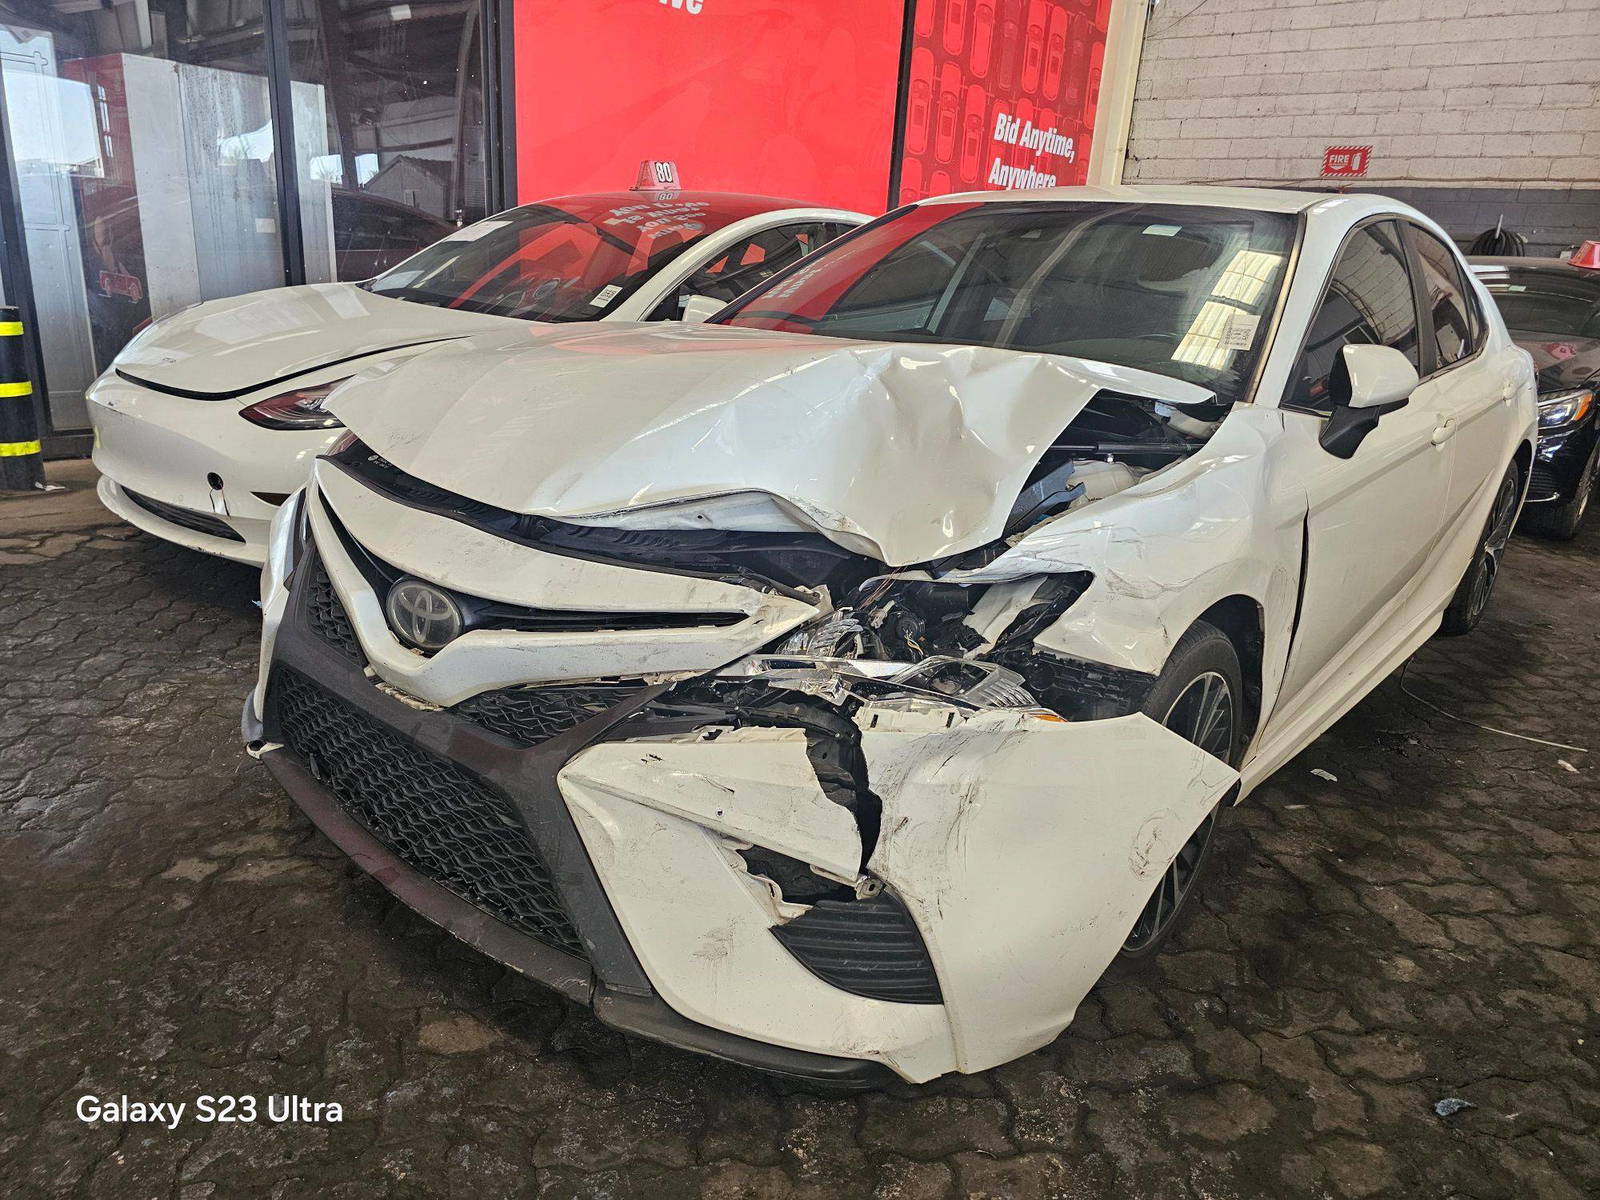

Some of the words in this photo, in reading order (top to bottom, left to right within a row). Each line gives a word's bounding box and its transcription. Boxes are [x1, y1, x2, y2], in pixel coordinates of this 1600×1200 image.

[994, 112, 1021, 145] Bid
[1019, 120, 1075, 164] Anytime,
[1329, 154, 1350, 163] FIRE
[655, 162, 674, 183] 80
[988, 157, 1056, 191] Anywhere
